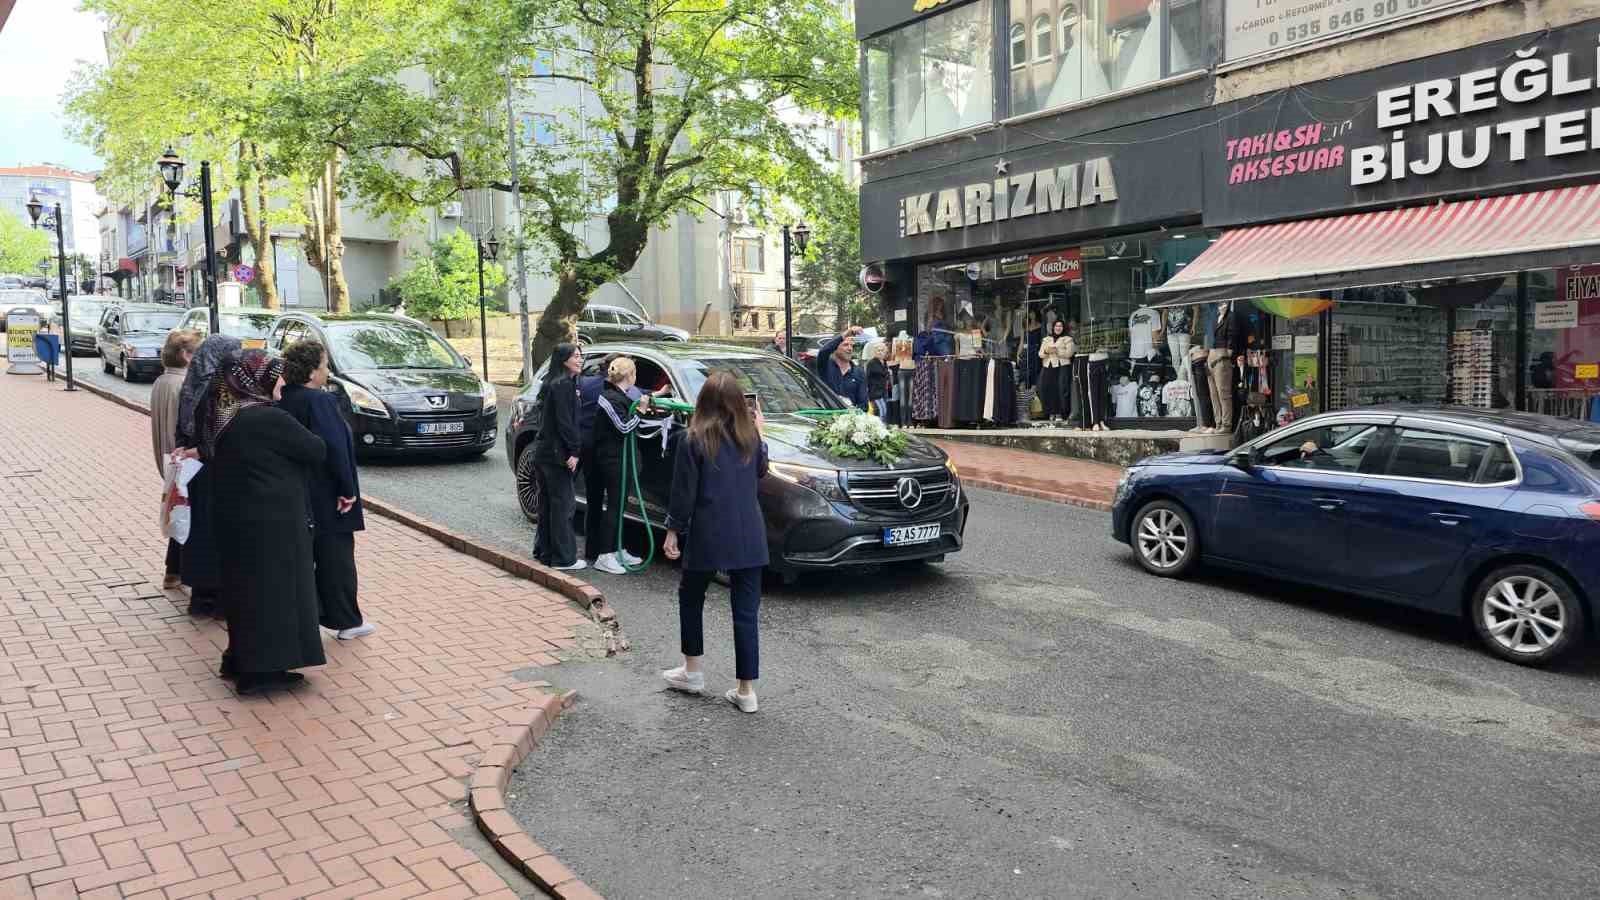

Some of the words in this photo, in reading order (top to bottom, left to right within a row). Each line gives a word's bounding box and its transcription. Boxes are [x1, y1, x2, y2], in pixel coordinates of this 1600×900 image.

[1269, 32, 1279, 46] 0
[1286, 20, 1321, 41] 535
[1328, 8, 1365, 30] 646
[1373, 0, 1398, 18] 90
[1377, 46, 1600, 129] EREĞL
[1229, 145, 1345, 185] AKSESUAR
[1350, 107, 1600, 186] BİJUTE
[906, 157, 1119, 236] KARİZMA
[1042, 256, 1080, 274] KARİZMA
[1567, 272, 1600, 299] FİYA
[890, 529, 902, 542] 52
[904, 527, 916, 541] AS
[917, 525, 939, 539] 7777
